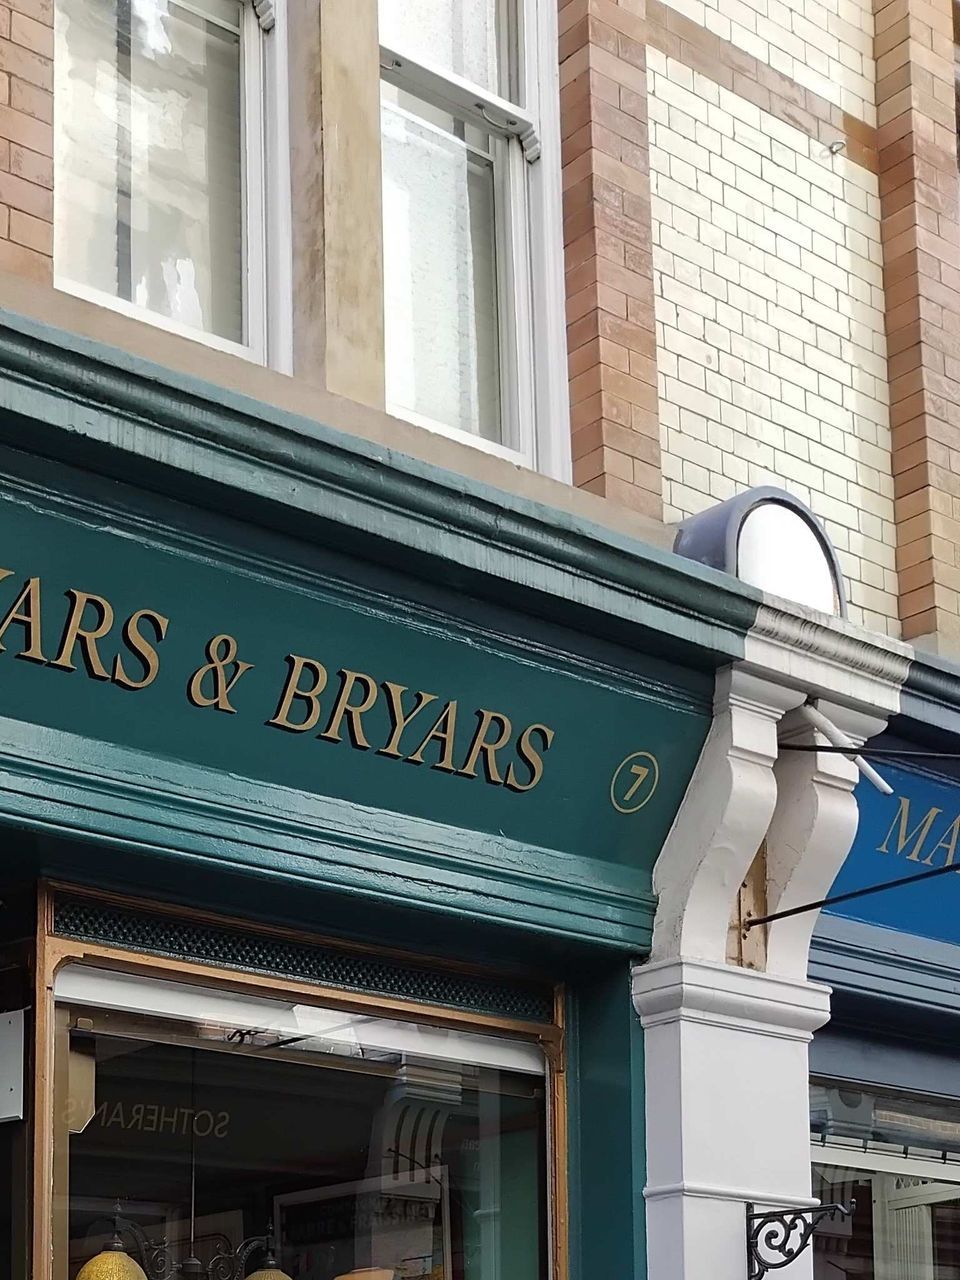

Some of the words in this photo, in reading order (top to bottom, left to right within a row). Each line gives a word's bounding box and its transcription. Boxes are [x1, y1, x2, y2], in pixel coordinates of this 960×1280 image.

[187, 633, 253, 714] &
[267, 653, 556, 792] BRYARS
[623, 764, 649, 801] 7
